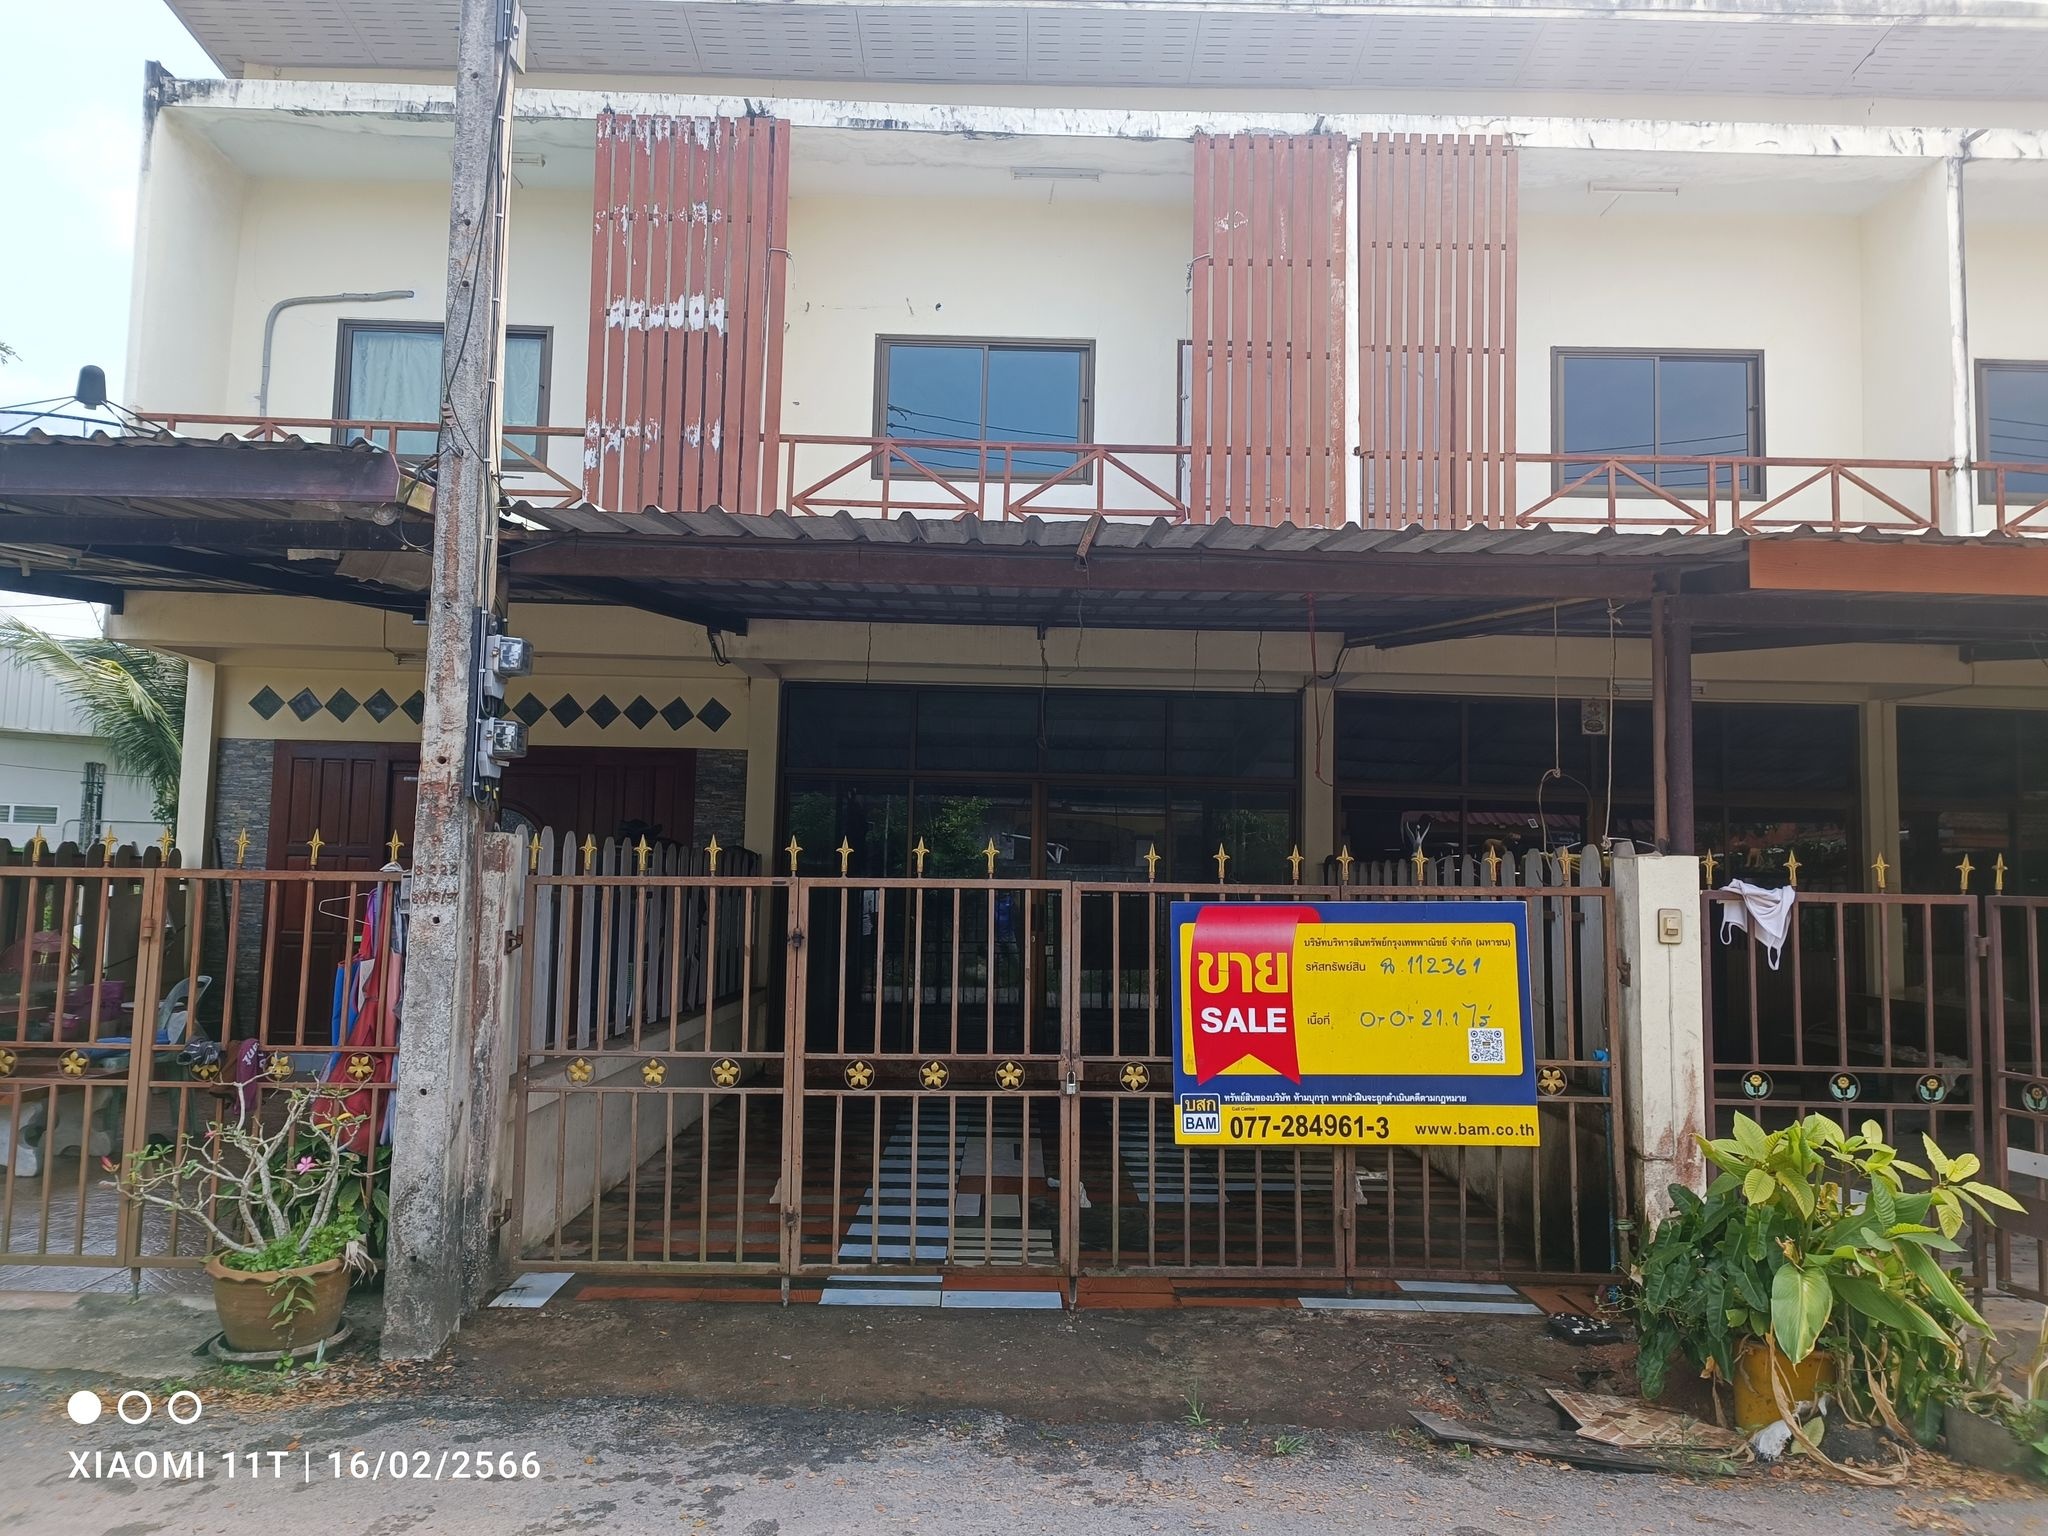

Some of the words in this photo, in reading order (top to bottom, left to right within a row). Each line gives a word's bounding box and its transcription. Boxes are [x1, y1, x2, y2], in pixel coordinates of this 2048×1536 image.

[1451, 936, 1472, 947] จำกัด
[1475, 937, 1511, 948] (มหาชน)
[1198, 951, 1289, 994] ขาย
[1305, 959, 1366, 972] รหัสทรัพย์สิน
[1200, 1007, 1287, 1033] SALE
[1306, 1011, 1331, 1026] เนื้อที่
[1184, 1099, 1217, 1112] บสก
[1223, 1091, 1291, 1102] ทรัพย์สินของบริษัท
[1293, 1091, 1329, 1105] ห้ามบุกรุก
[1185, 1116, 1217, 1131] BAM
[1230, 1114, 1390, 1139] 077-284961-3
[1415, 1122, 1535, 1137] www.bam.co.th
